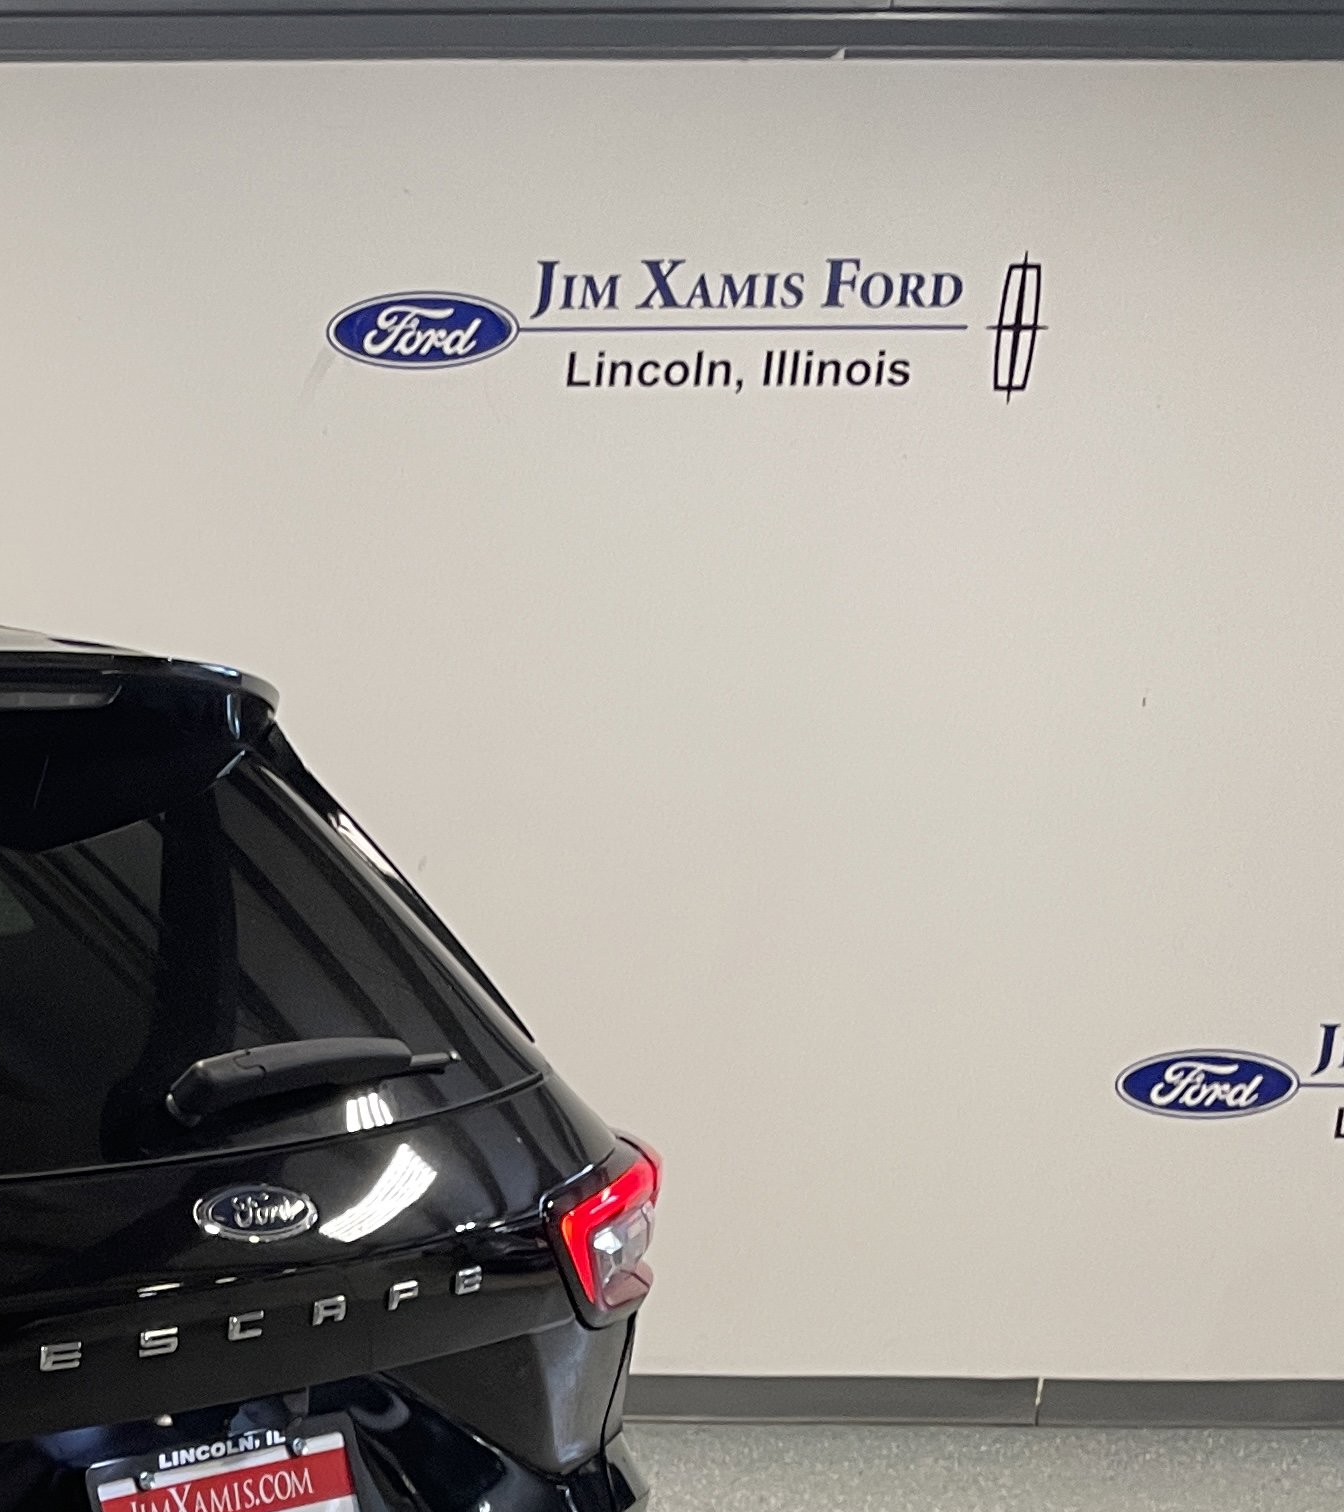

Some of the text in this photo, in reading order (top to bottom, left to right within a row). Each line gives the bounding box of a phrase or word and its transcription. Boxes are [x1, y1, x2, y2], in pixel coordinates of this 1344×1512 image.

[530, 258, 964, 319] JIM XAMIS FORD
[363, 304, 477, 356] Ford
[566, 349, 911, 391] Lincoln, Illinois
[1149, 1060, 1264, 1107] Ford
[230, 1193, 306, 1229] Ford
[39, 1265, 483, 1372] ESCAPE
[158, 1429, 287, 1469] LINCOLN, IL
